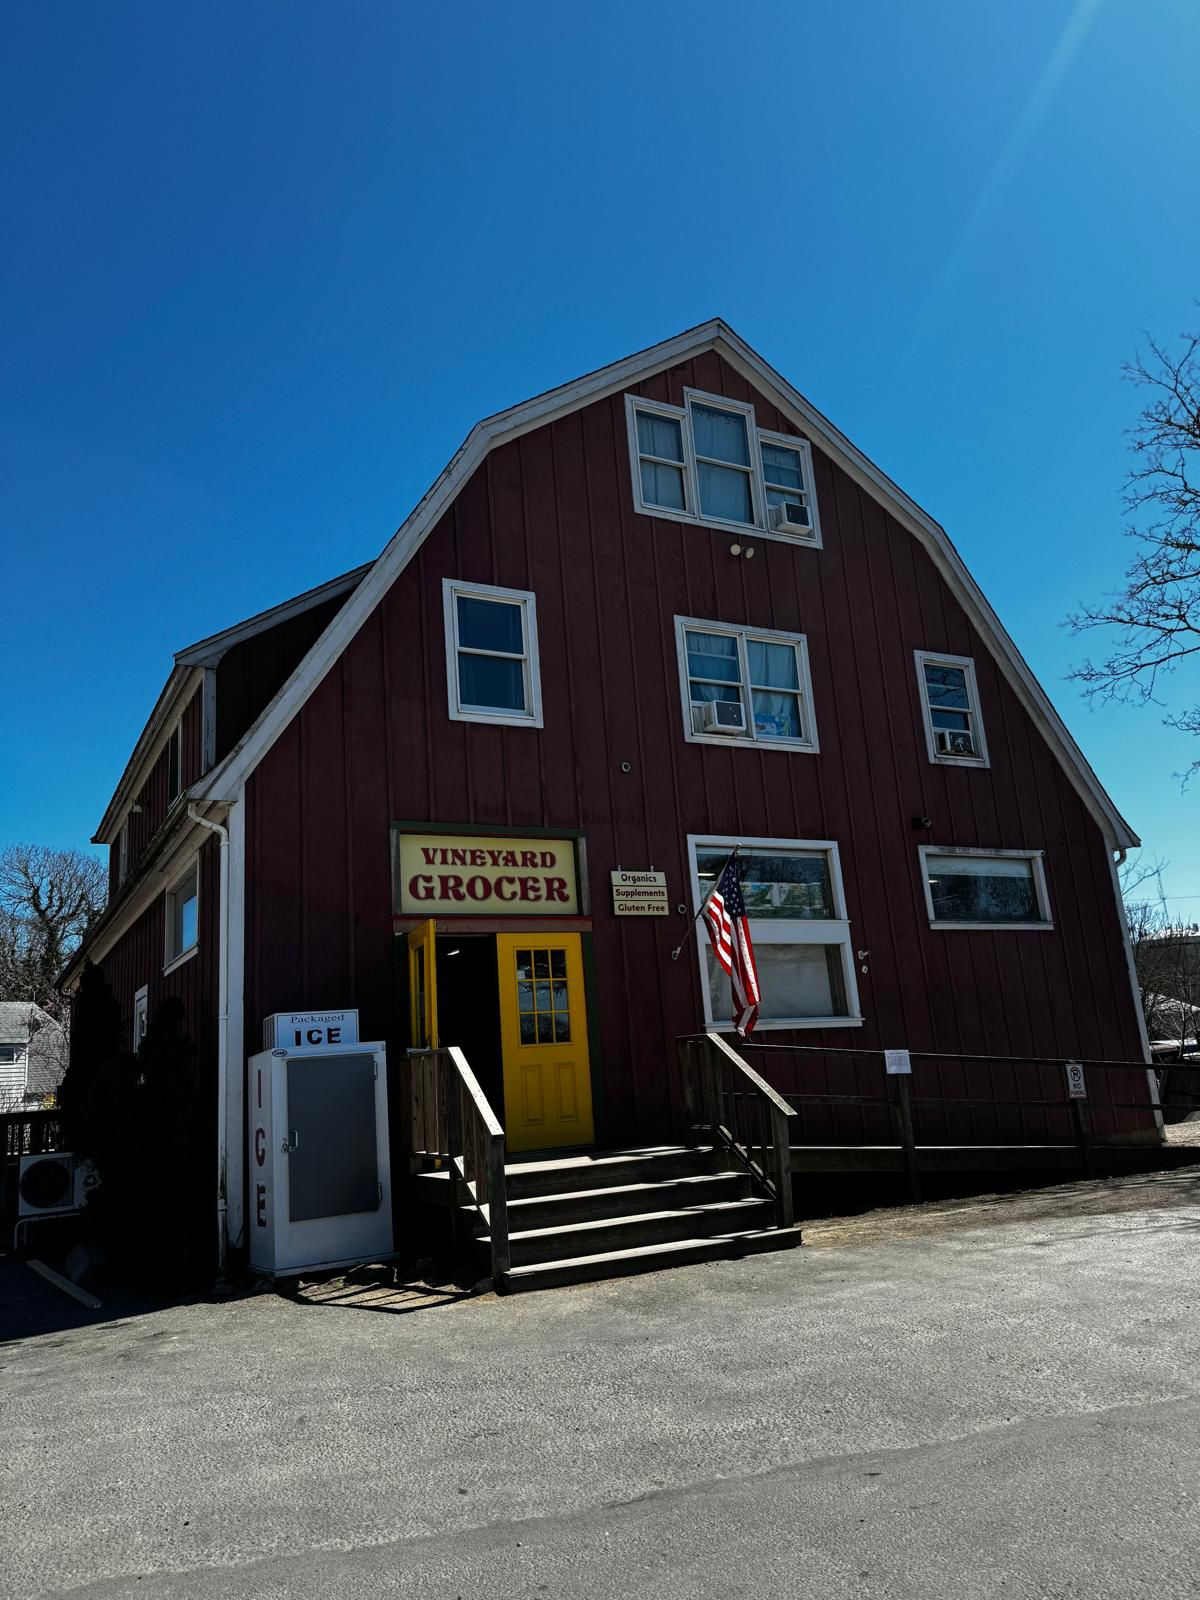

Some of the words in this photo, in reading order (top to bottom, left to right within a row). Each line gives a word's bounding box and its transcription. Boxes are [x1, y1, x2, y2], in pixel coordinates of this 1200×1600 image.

[421, 847, 557, 868] VINEYARD
[621, 873, 657, 884] Organics
[408, 874, 570, 902] GROCER
[615, 888, 666, 898] Supplements
[618, 903, 646, 912] Gluten
[647, 904, 665, 912] Free
[291, 1014, 344, 1024] Packaged
[295, 1027, 342, 1046] ICE
[255, 1069, 267, 1228] ICE
